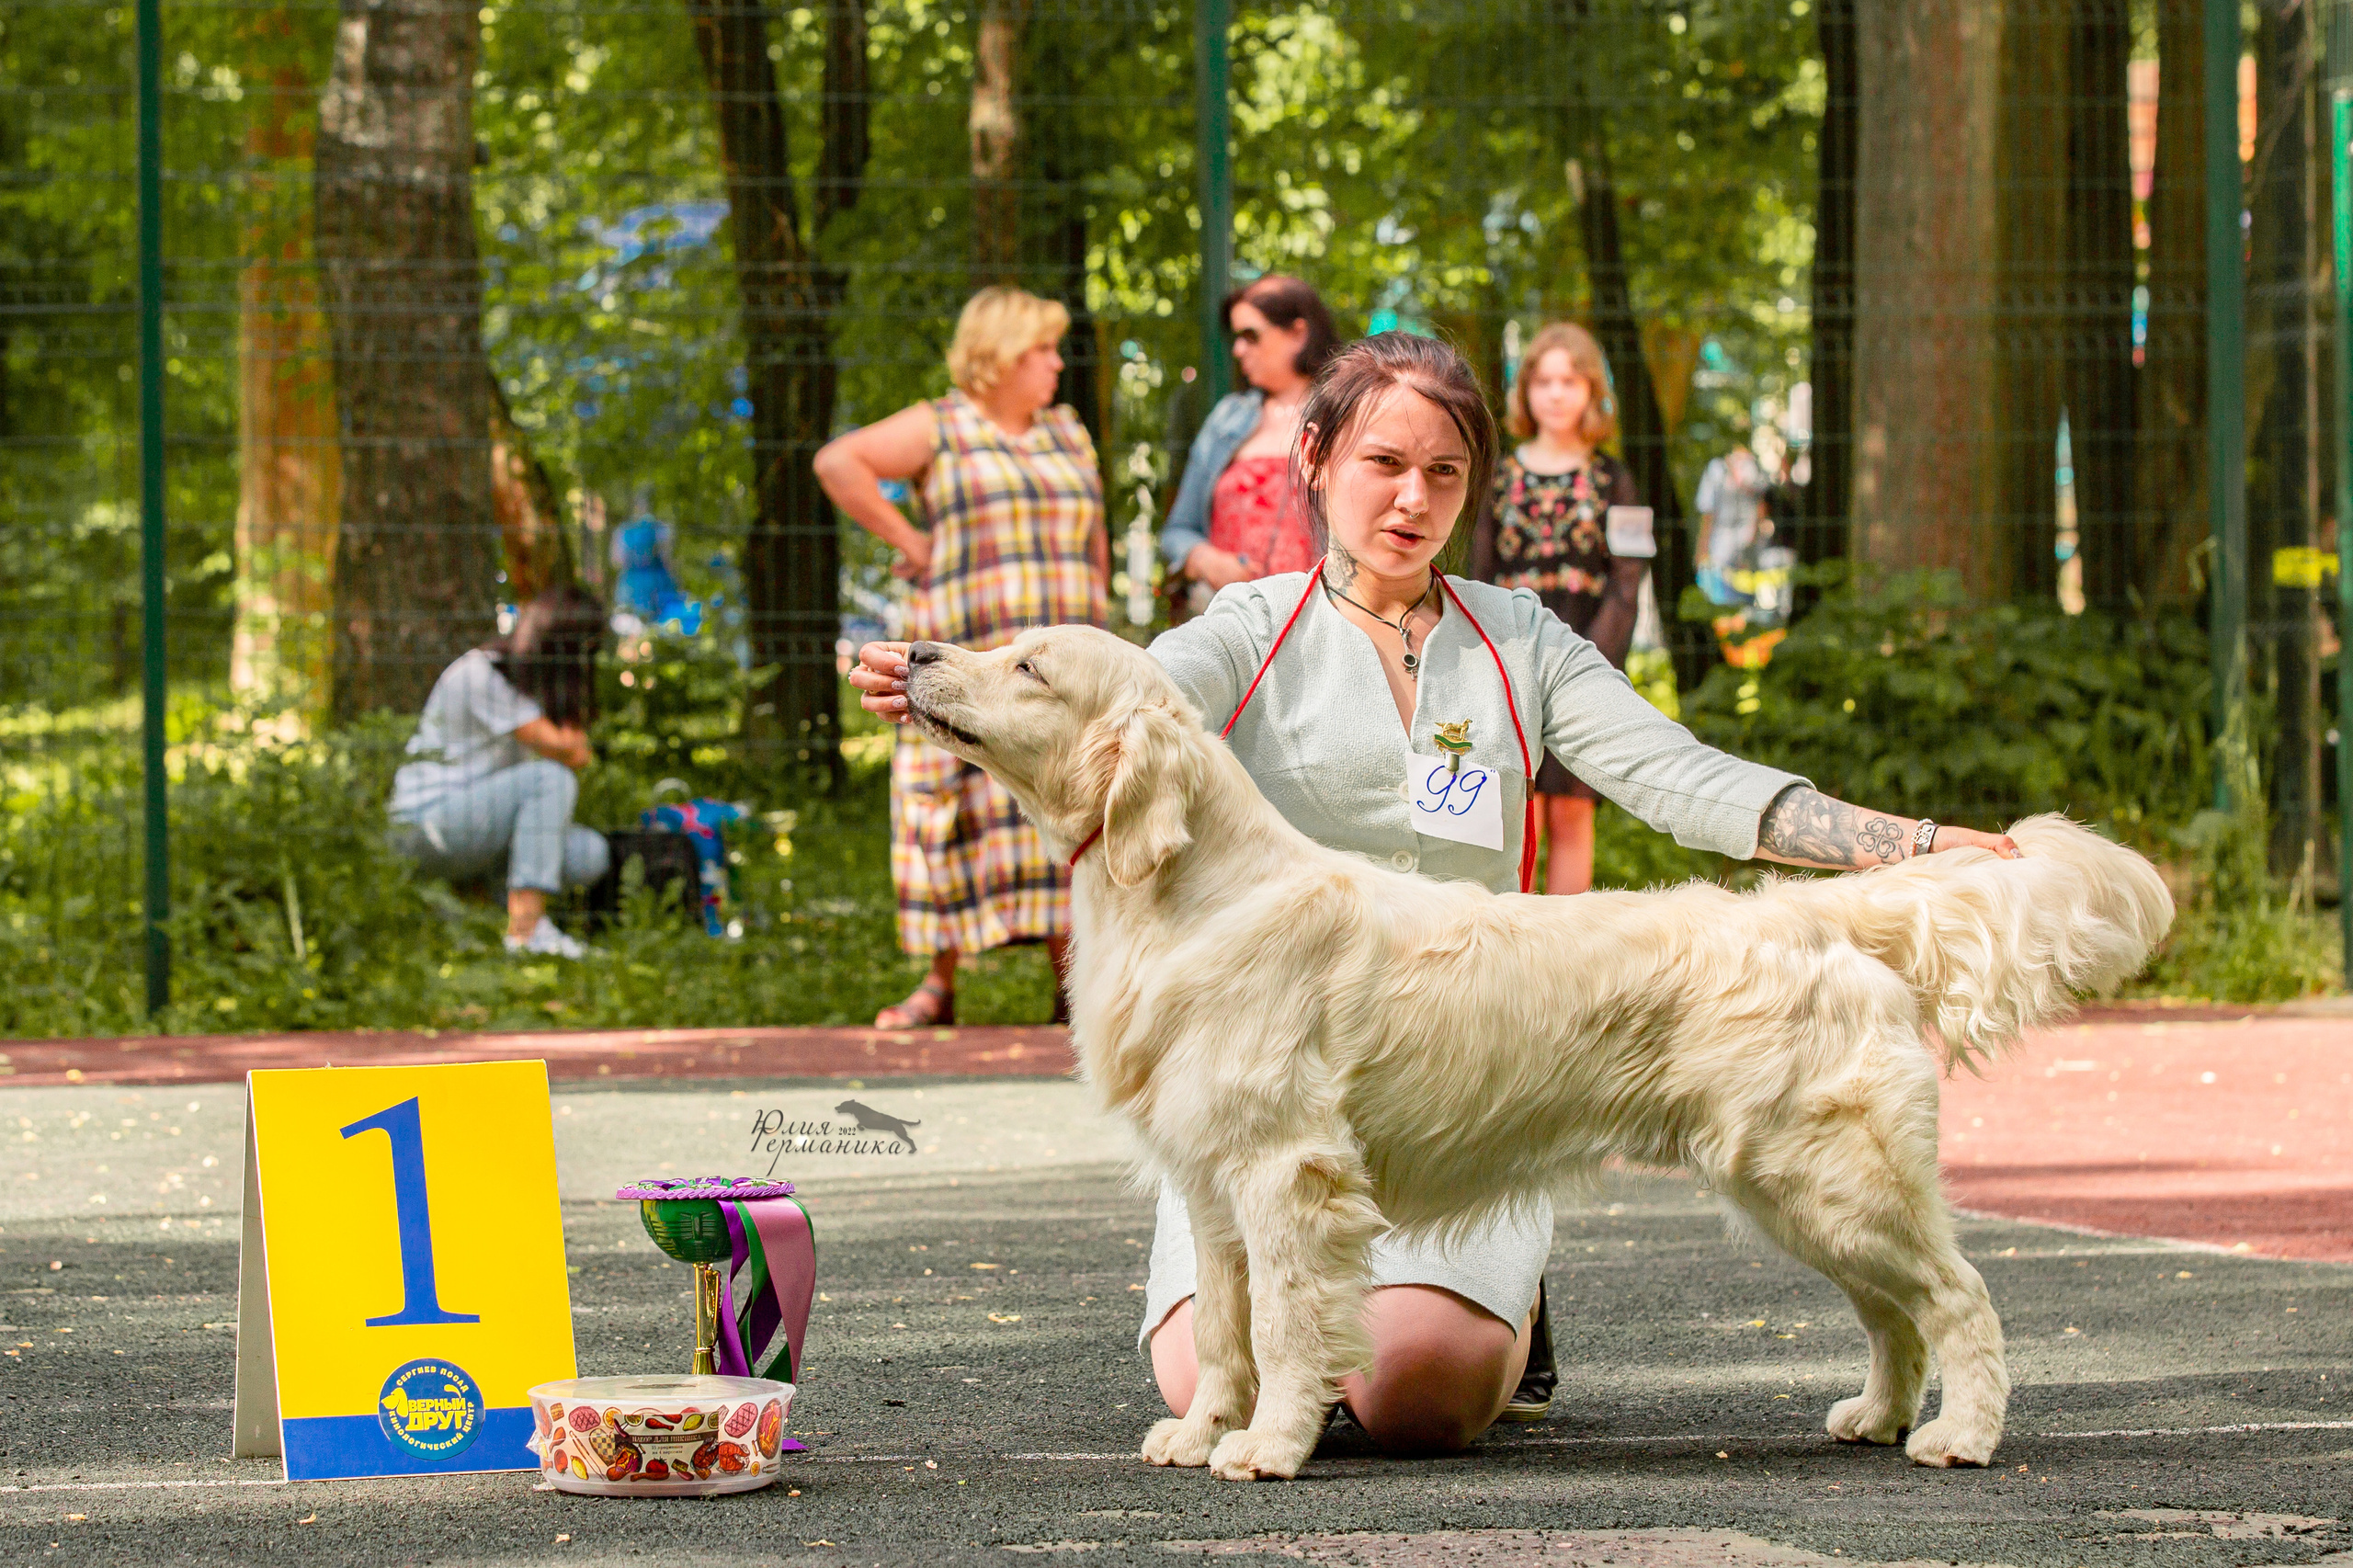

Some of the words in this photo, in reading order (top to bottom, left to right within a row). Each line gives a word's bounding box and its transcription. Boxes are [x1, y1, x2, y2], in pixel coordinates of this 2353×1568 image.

[339, 1096, 481, 1327] 1
[396, 1366, 437, 1386] СЕРГИЕВ
[439, 1368, 469, 1392] ПОСАД
[389, 1411, 464, 1450] КИНОЛОГИЧЕСКИЙ
[462, 1402, 474, 1433] ЦЕНТР
[404, 1410, 467, 1431] ДРУГ
[670, 1434, 701, 1442] ПИКНИКА
